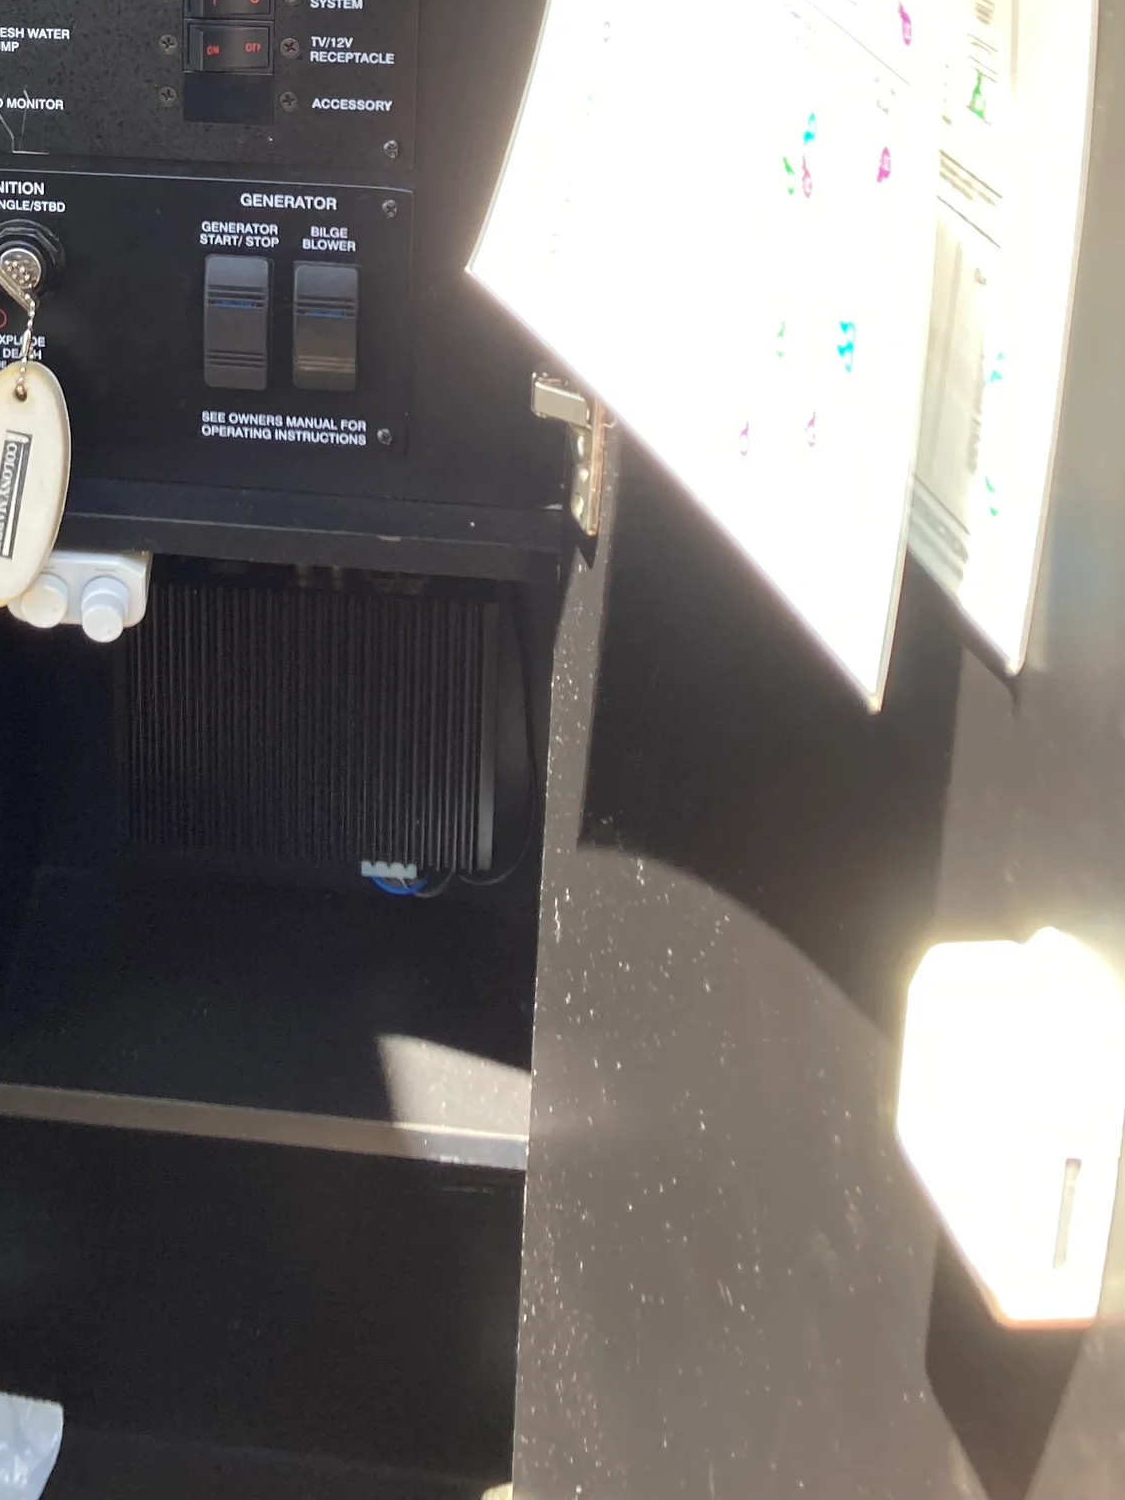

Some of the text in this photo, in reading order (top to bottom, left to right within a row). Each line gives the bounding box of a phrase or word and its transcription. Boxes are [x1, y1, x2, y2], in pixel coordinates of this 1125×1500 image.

[27, 28, 69, 39] WATER
[311, 36, 353, 48] TV/12V
[207, 43, 261, 55] ON OFF
[310, 51, 394, 64] RECEPTACLE
[7, 98, 64, 109] MONITOR
[312, 98, 392, 111] ACCESSORY
[241, 193, 336, 210] GENERATOR
[202, 221, 278, 235] GENERATOR
[311, 226, 347, 238] BILGE
[200, 234, 279, 247] START/ STOP
[303, 239, 355, 251] BLOWER
[202, 411, 366, 432] SEE OWNERS MANUAL FOR
[202, 425, 366, 445] OPERATING INSTRUCTIONS
[0, 443, 17, 496] COLONY
